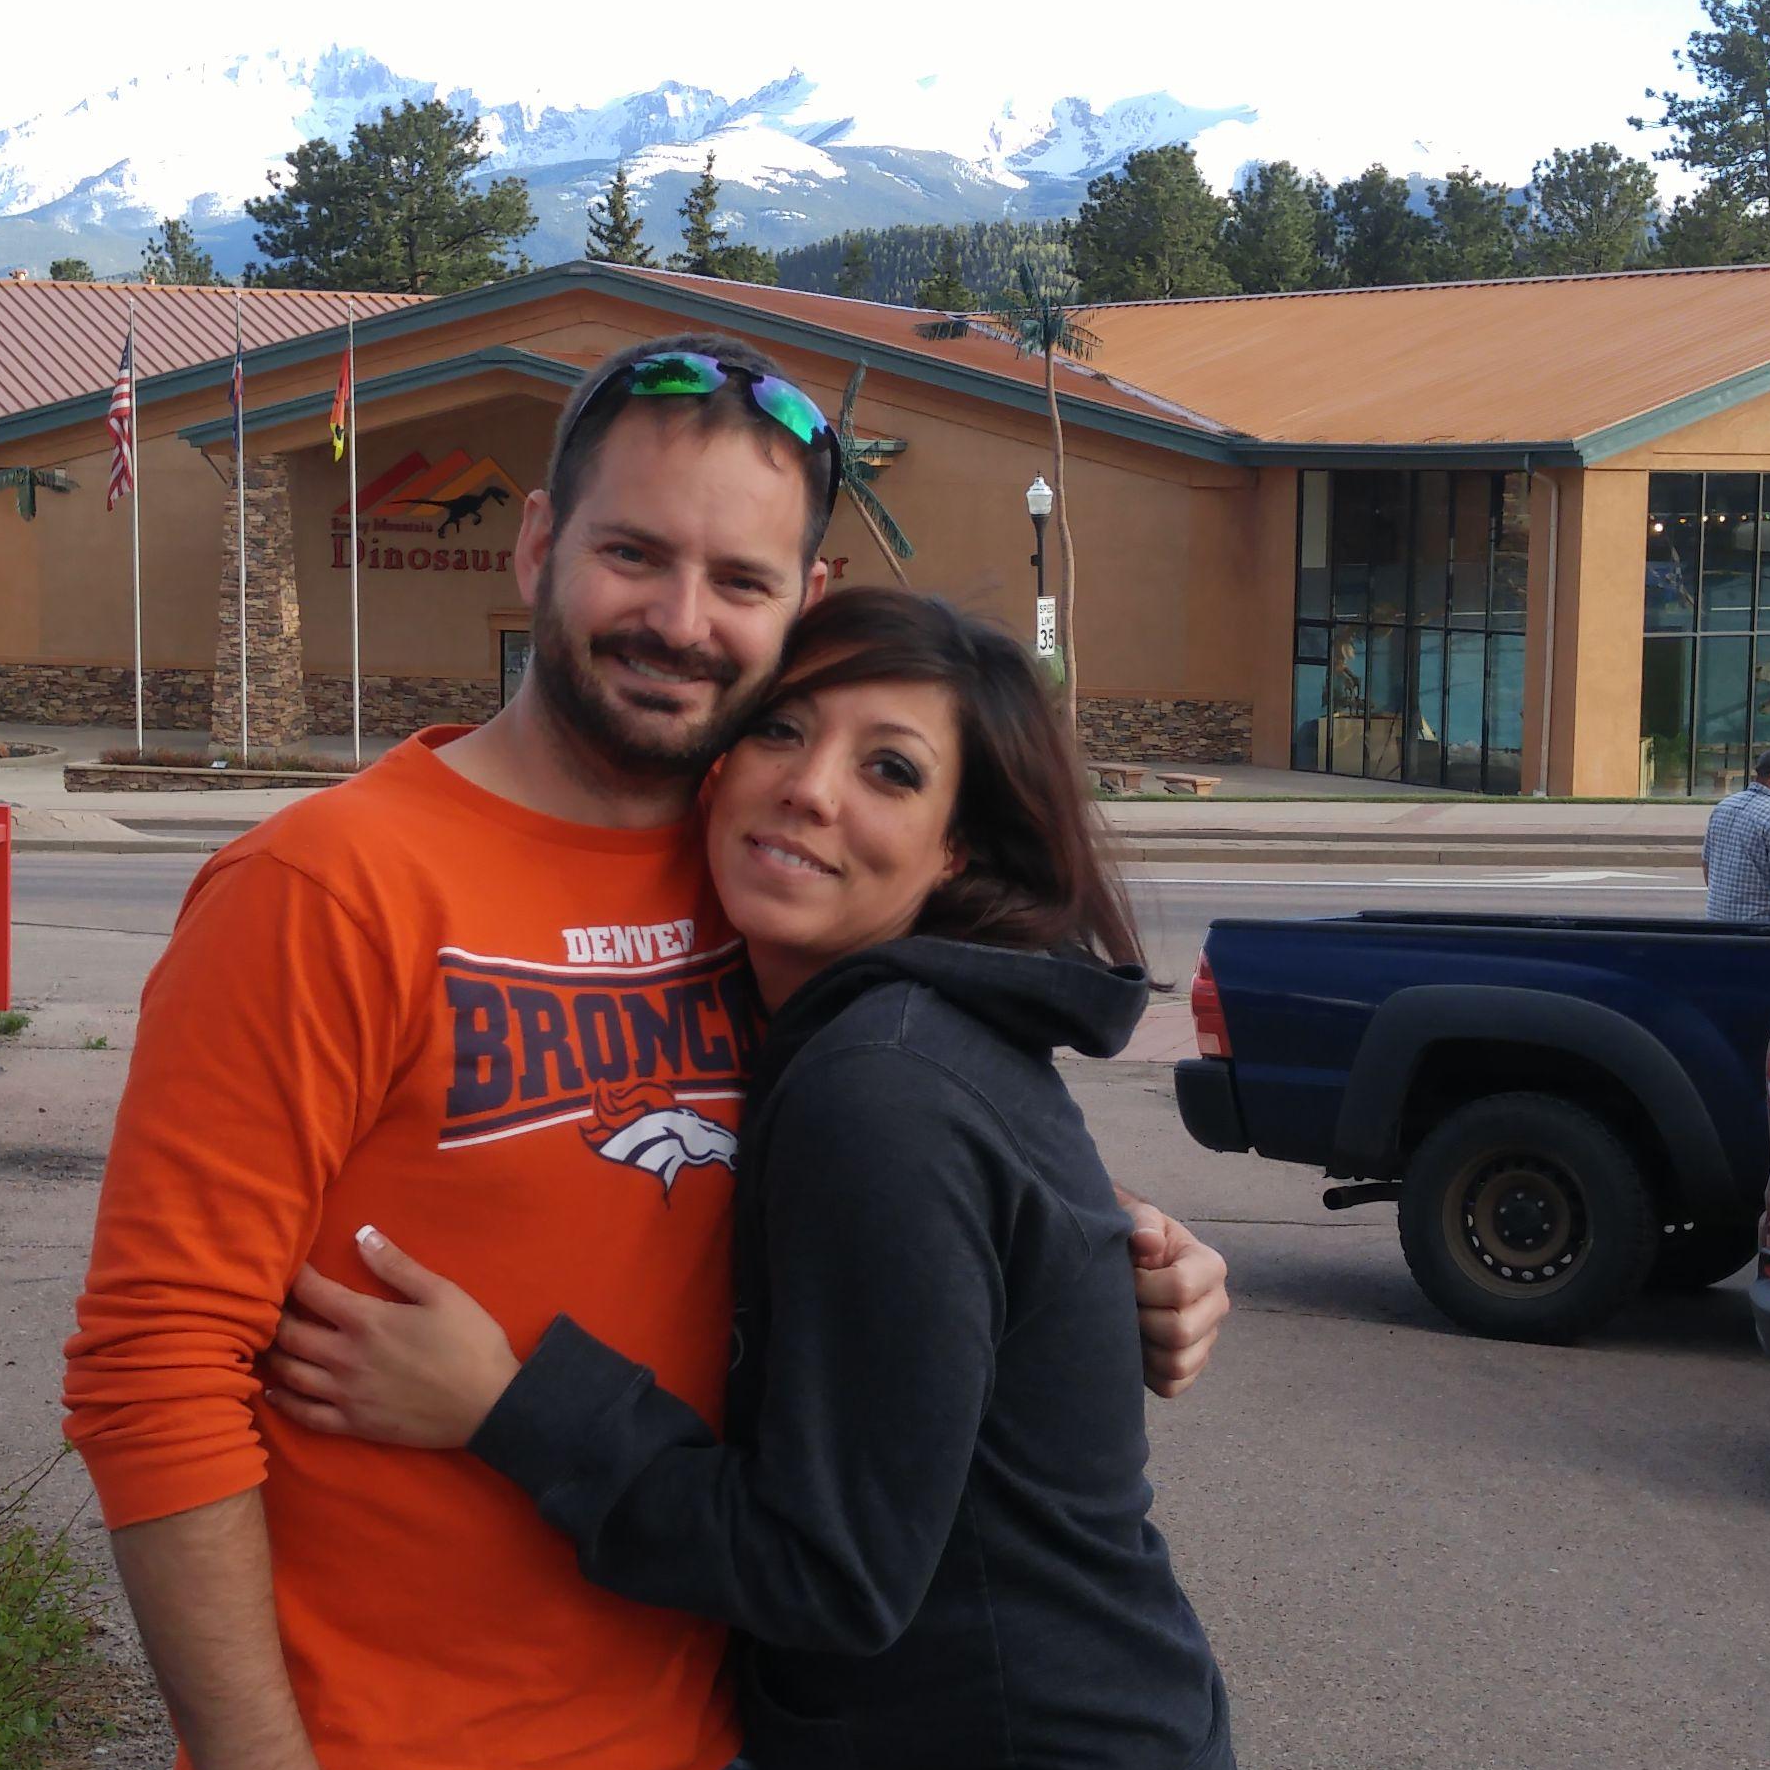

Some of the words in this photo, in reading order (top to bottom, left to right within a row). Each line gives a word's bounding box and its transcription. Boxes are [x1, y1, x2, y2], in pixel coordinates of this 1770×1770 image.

[331, 532, 513, 572] Dinosaur
[1040, 628, 1054, 650] 35
[561, 919, 695, 964] DENVER
[444, 970, 762, 1119] BRONCO
